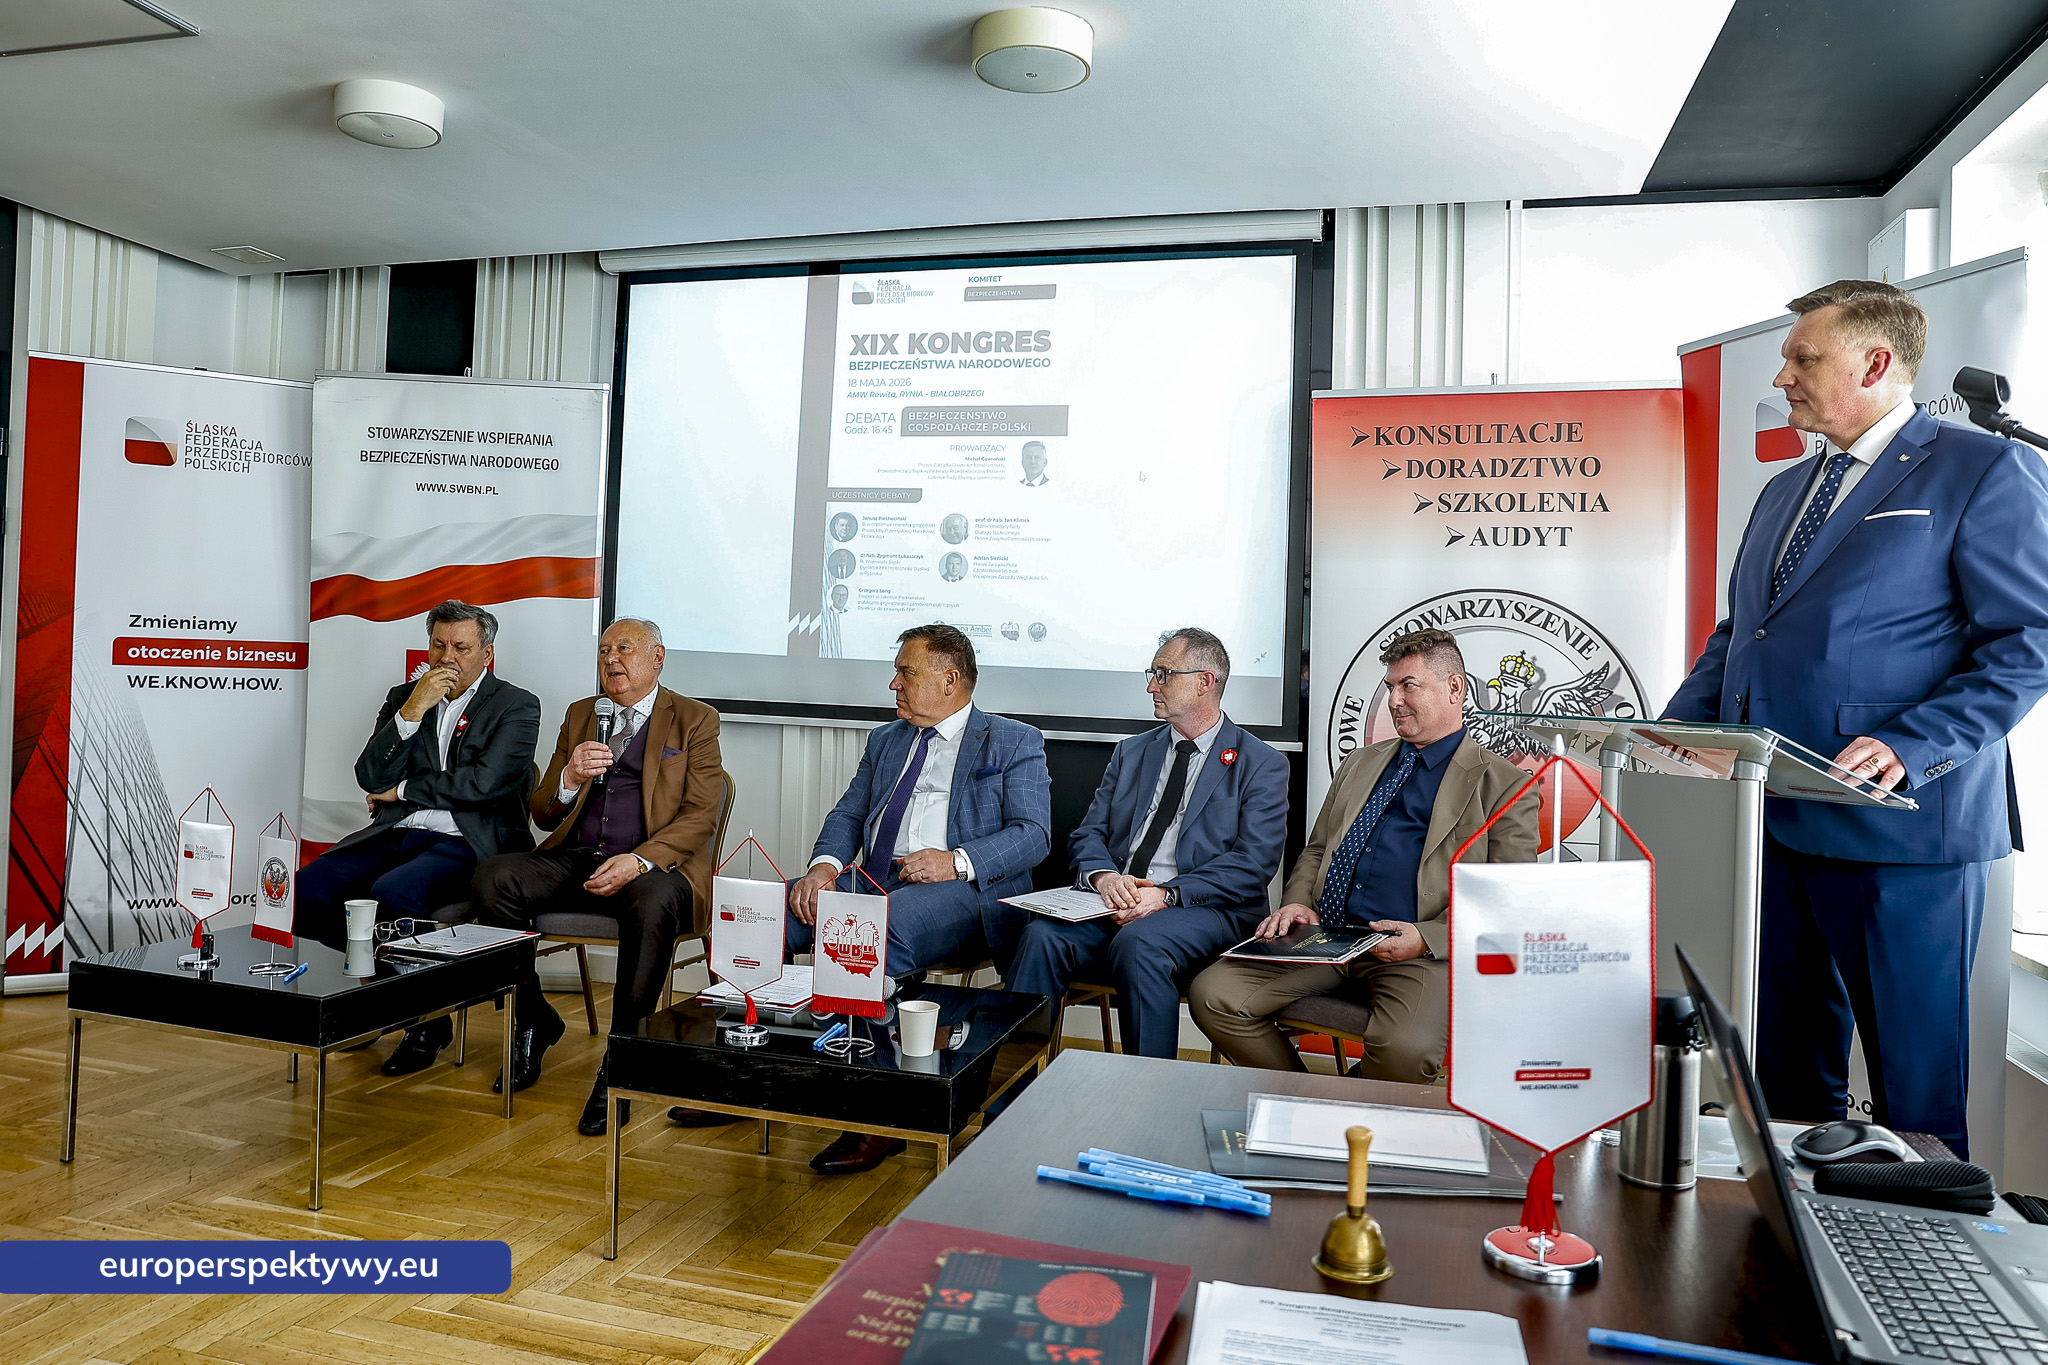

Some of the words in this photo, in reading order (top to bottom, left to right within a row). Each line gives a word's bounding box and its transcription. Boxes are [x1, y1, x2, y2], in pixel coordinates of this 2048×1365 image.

[877, 279, 901, 287] ŚLĄSKA
[968, 275, 1002, 283] KOMITET
[849, 333, 900, 356] XIX
[908, 329, 1052, 355] KONGRES
[849, 358, 954, 371] BEZPIECZEŃSTWA
[958, 357, 1051, 369] NARODOWEGO
[848, 378, 857, 387] 18
[859, 378, 888, 387] MAJA
[890, 377, 912, 387] 2026
[847, 391, 868, 399] AMW
[869, 391, 897, 399] Rewita,
[899, 390, 923, 398] RYNIA
[930, 389, 985, 398] BIAŁOBRZEGI
[845, 412, 896, 424] DEBATA
[908, 410, 1007, 421] BEZPIECZEŃSTWO
[185, 419, 238, 440] ŚLĄSKA
[845, 425, 870, 435] Godz.
[872, 425, 893, 434] 16:45
[908, 422, 989, 432] GOSPODARCZE
[992, 421, 1031, 432] POLSKI
[1373, 422, 1584, 446] KONSULTACJE
[184, 433, 264, 452] FEDERACJA
[366, 425, 475, 444] STOWARZYSZENIE
[477, 429, 553, 447] WSPIERANIA
[950, 444, 1006, 453] PROWADZĄCY
[184, 446, 313, 468] PRZEDSIĘBIORCÓW
[359, 449, 467, 468] BEZPIECZEŃSTWA
[469, 453, 560, 472] NARODOWEGO
[184, 457, 251, 475] POLSKICH
[1405, 456, 1602, 480] DORADZTWO
[415, 482, 499, 497] WWW.SWBN.PL
[832, 491, 879, 499] UCZESTNICY
[880, 491, 911, 499] DEBATY
[1437, 492, 1610, 514] SZKOLENIA
[1468, 526, 1573, 547] AUDYT
[128, 614, 238, 634] Zmieniamy
[127, 645, 222, 662] otoczenie
[226, 646, 297, 664] biznesu
[127, 674, 284, 692] WE.KNOW.HOW.
[1523, 932, 1567, 943] ŚLĄSKA
[1523, 942, 1589, 953] FEDERACJA
[1523, 963, 1580, 975] POLSKICH
